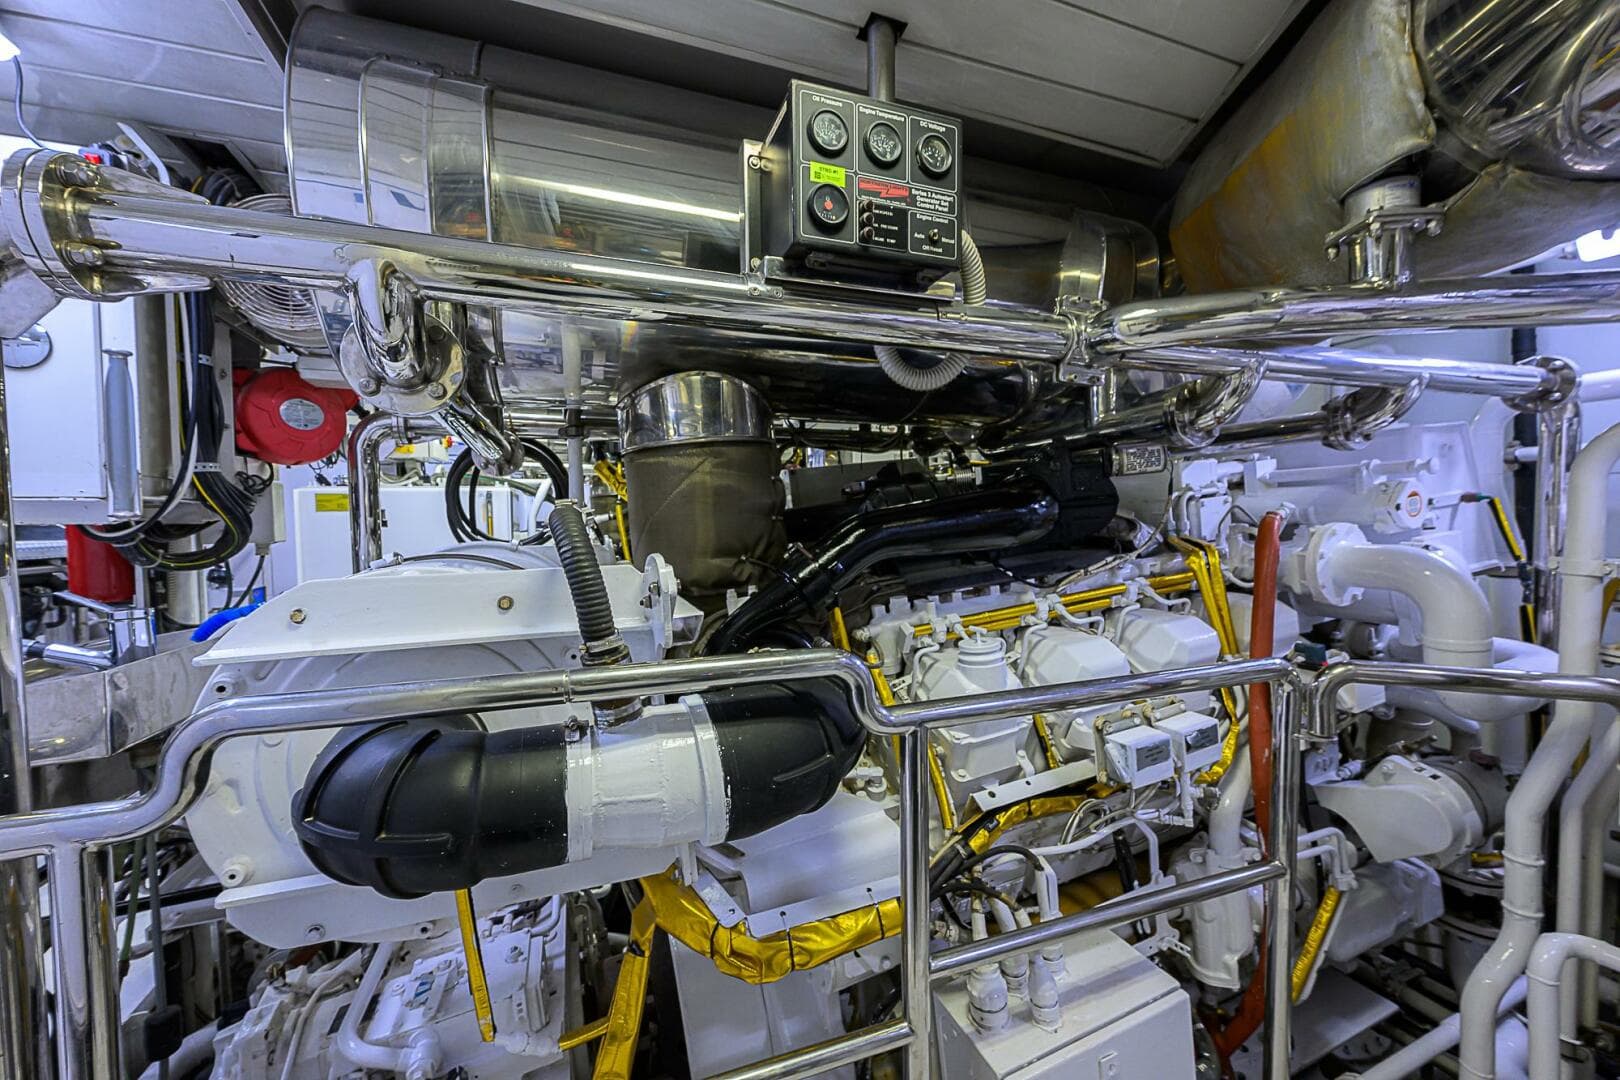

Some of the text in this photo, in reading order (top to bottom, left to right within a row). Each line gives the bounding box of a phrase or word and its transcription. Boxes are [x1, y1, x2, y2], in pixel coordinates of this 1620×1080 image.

[820, 97, 843, 107] Pressure
[859, 106, 905, 122] Engine Temperature
[919, 120, 946, 133] DC Voltage
[911, 188, 927, 196] Series
[931, 192, 954, 202] Autostart
[916, 195, 940, 205] Generator
[916, 201, 949, 212] Control Panel
[916, 213, 949, 224] Engine Control
[914, 231, 925, 239] Auto
